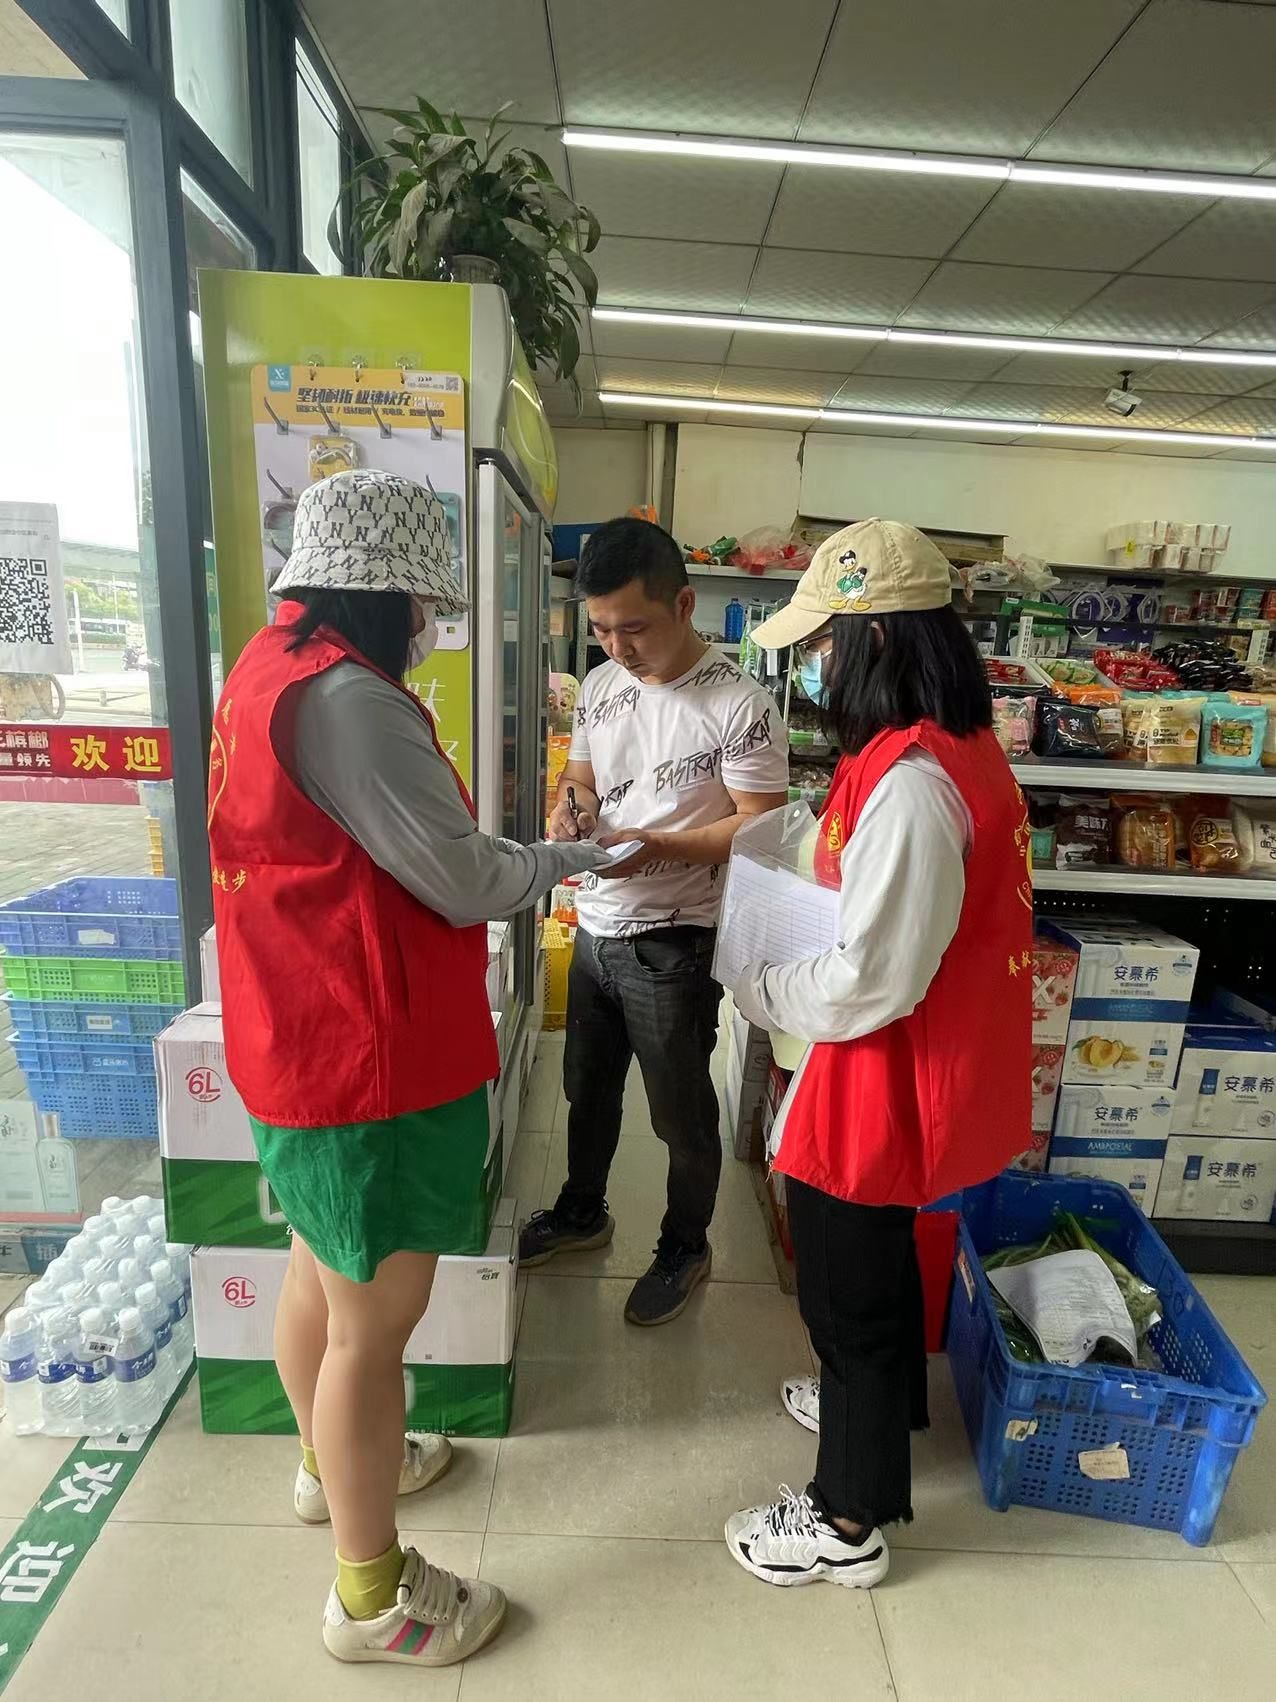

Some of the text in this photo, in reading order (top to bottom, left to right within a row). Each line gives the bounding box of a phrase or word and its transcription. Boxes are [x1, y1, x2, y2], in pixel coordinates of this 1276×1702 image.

[70, 734, 162, 773] 欢迎
[1113, 965, 1159, 982] 安慕希
[188, 1071, 221, 1095] 6L
[1224, 1076, 1275, 1094] 安慕希
[1094, 1106, 1139, 1122] 安慕希
[1207, 1162, 1258, 1179] 安慕希
[224, 1279, 256, 1300] 6L
